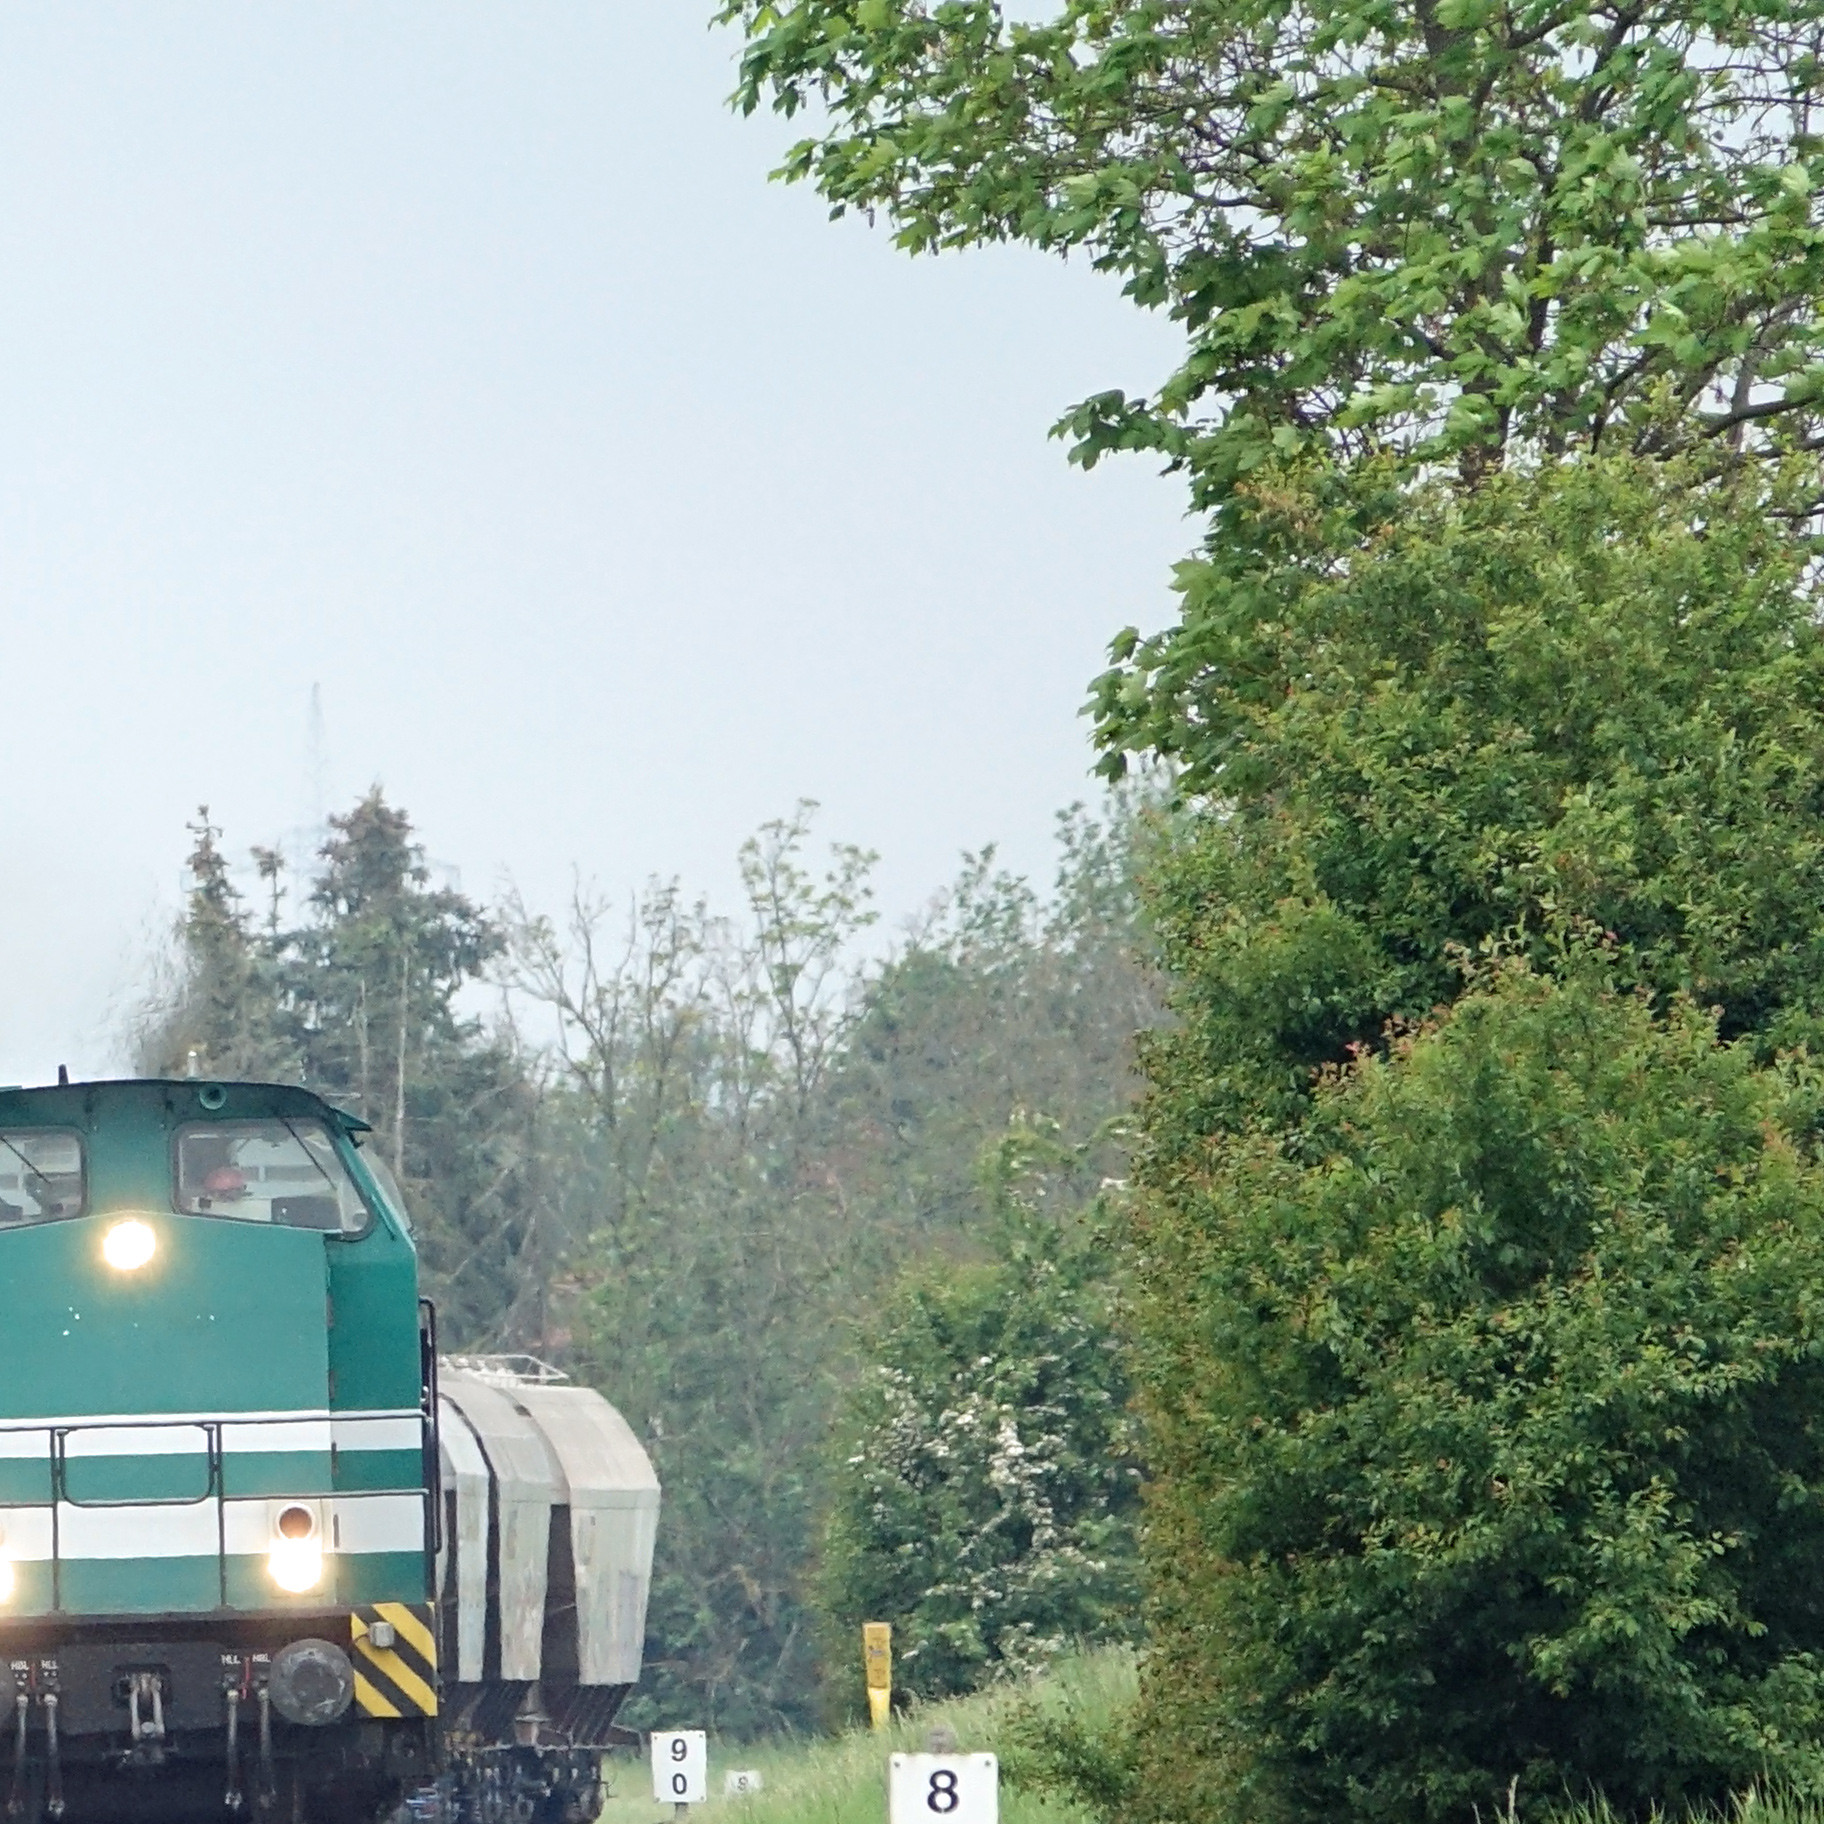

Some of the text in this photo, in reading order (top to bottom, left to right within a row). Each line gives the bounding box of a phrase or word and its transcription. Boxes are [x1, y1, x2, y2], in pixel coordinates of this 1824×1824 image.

[671, 1738, 688, 1762] 9
[672, 1773, 688, 1795] 0
[927, 1769, 959, 1814] 8
